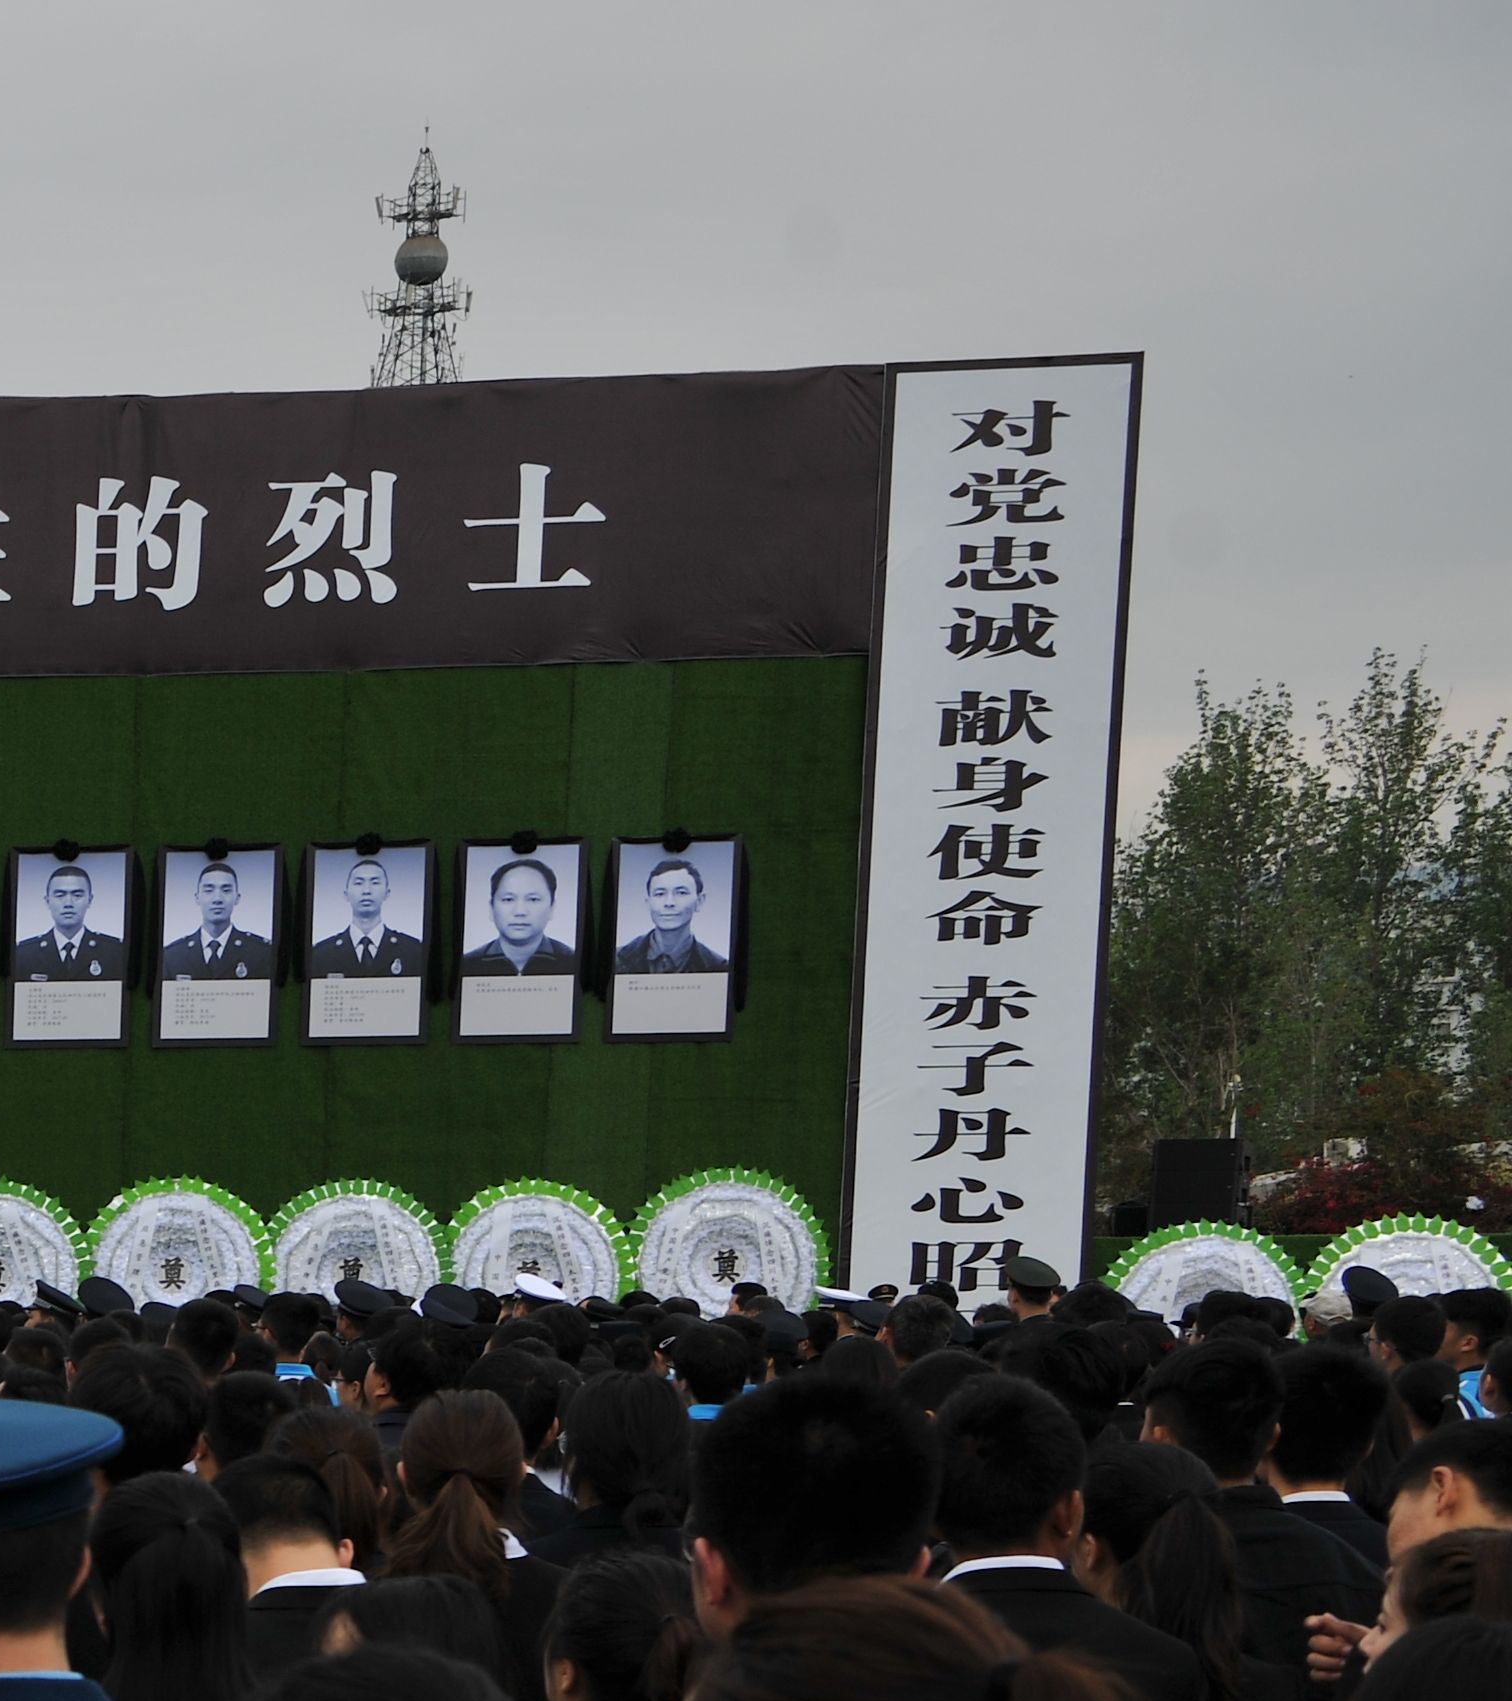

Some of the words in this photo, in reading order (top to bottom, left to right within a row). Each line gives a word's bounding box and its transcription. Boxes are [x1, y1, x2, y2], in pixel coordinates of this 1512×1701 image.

[940, 400, 1070, 660] 对党忠诚
[926, 690, 1053, 945] 献身使命
[909, 976, 1037, 1292] 赤子丹心昭
